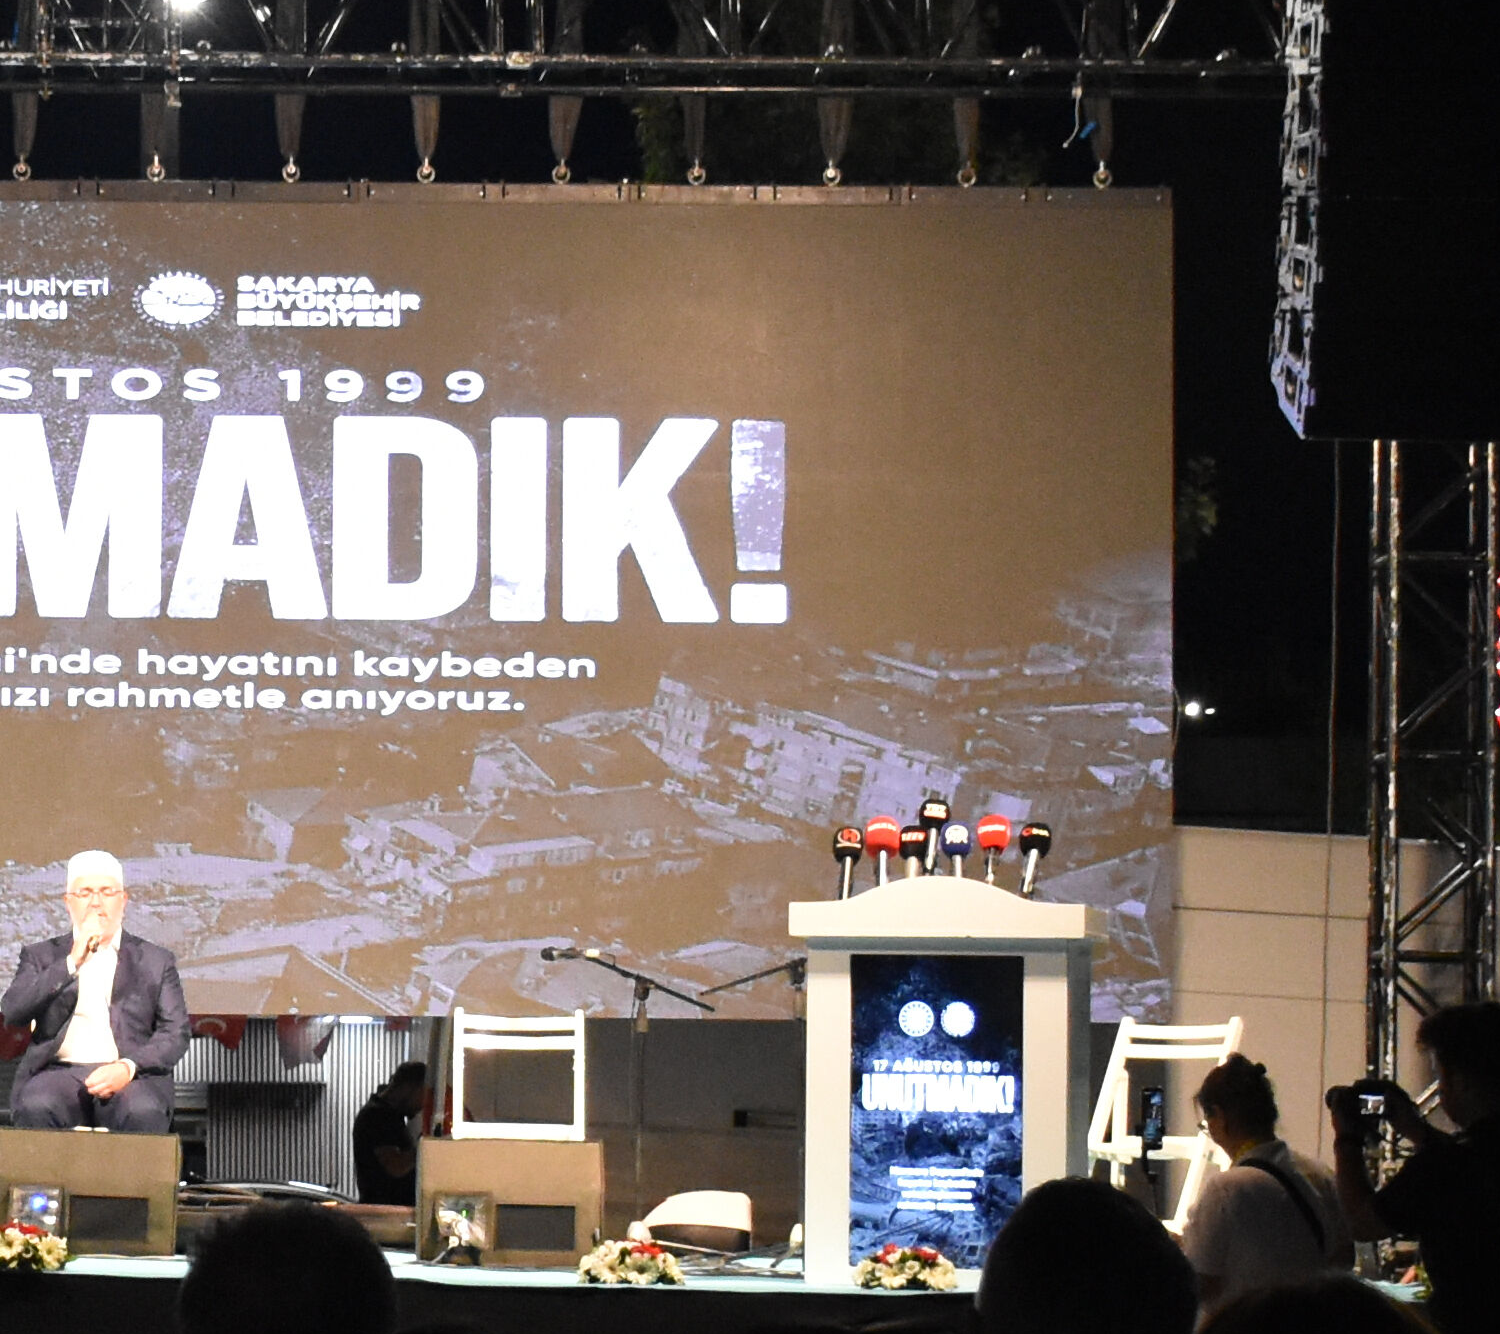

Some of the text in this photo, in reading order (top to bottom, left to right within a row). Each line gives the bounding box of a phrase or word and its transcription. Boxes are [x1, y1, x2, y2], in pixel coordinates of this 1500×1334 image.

[236, 275, 375, 293] SAKARYA
[236, 290, 421, 312] BÜYÜKŞEHİR
[236, 308, 401, 327] BELEDİYESİ
[278, 368, 487, 404] 1999
[137, 648, 337, 681] hayatını
[353, 650, 597, 683] kaybeden
[66, 682, 286, 709] rahmetle
[300, 688, 526, 716] anıyoruz.
[872, 1059, 889, 1072] 17
